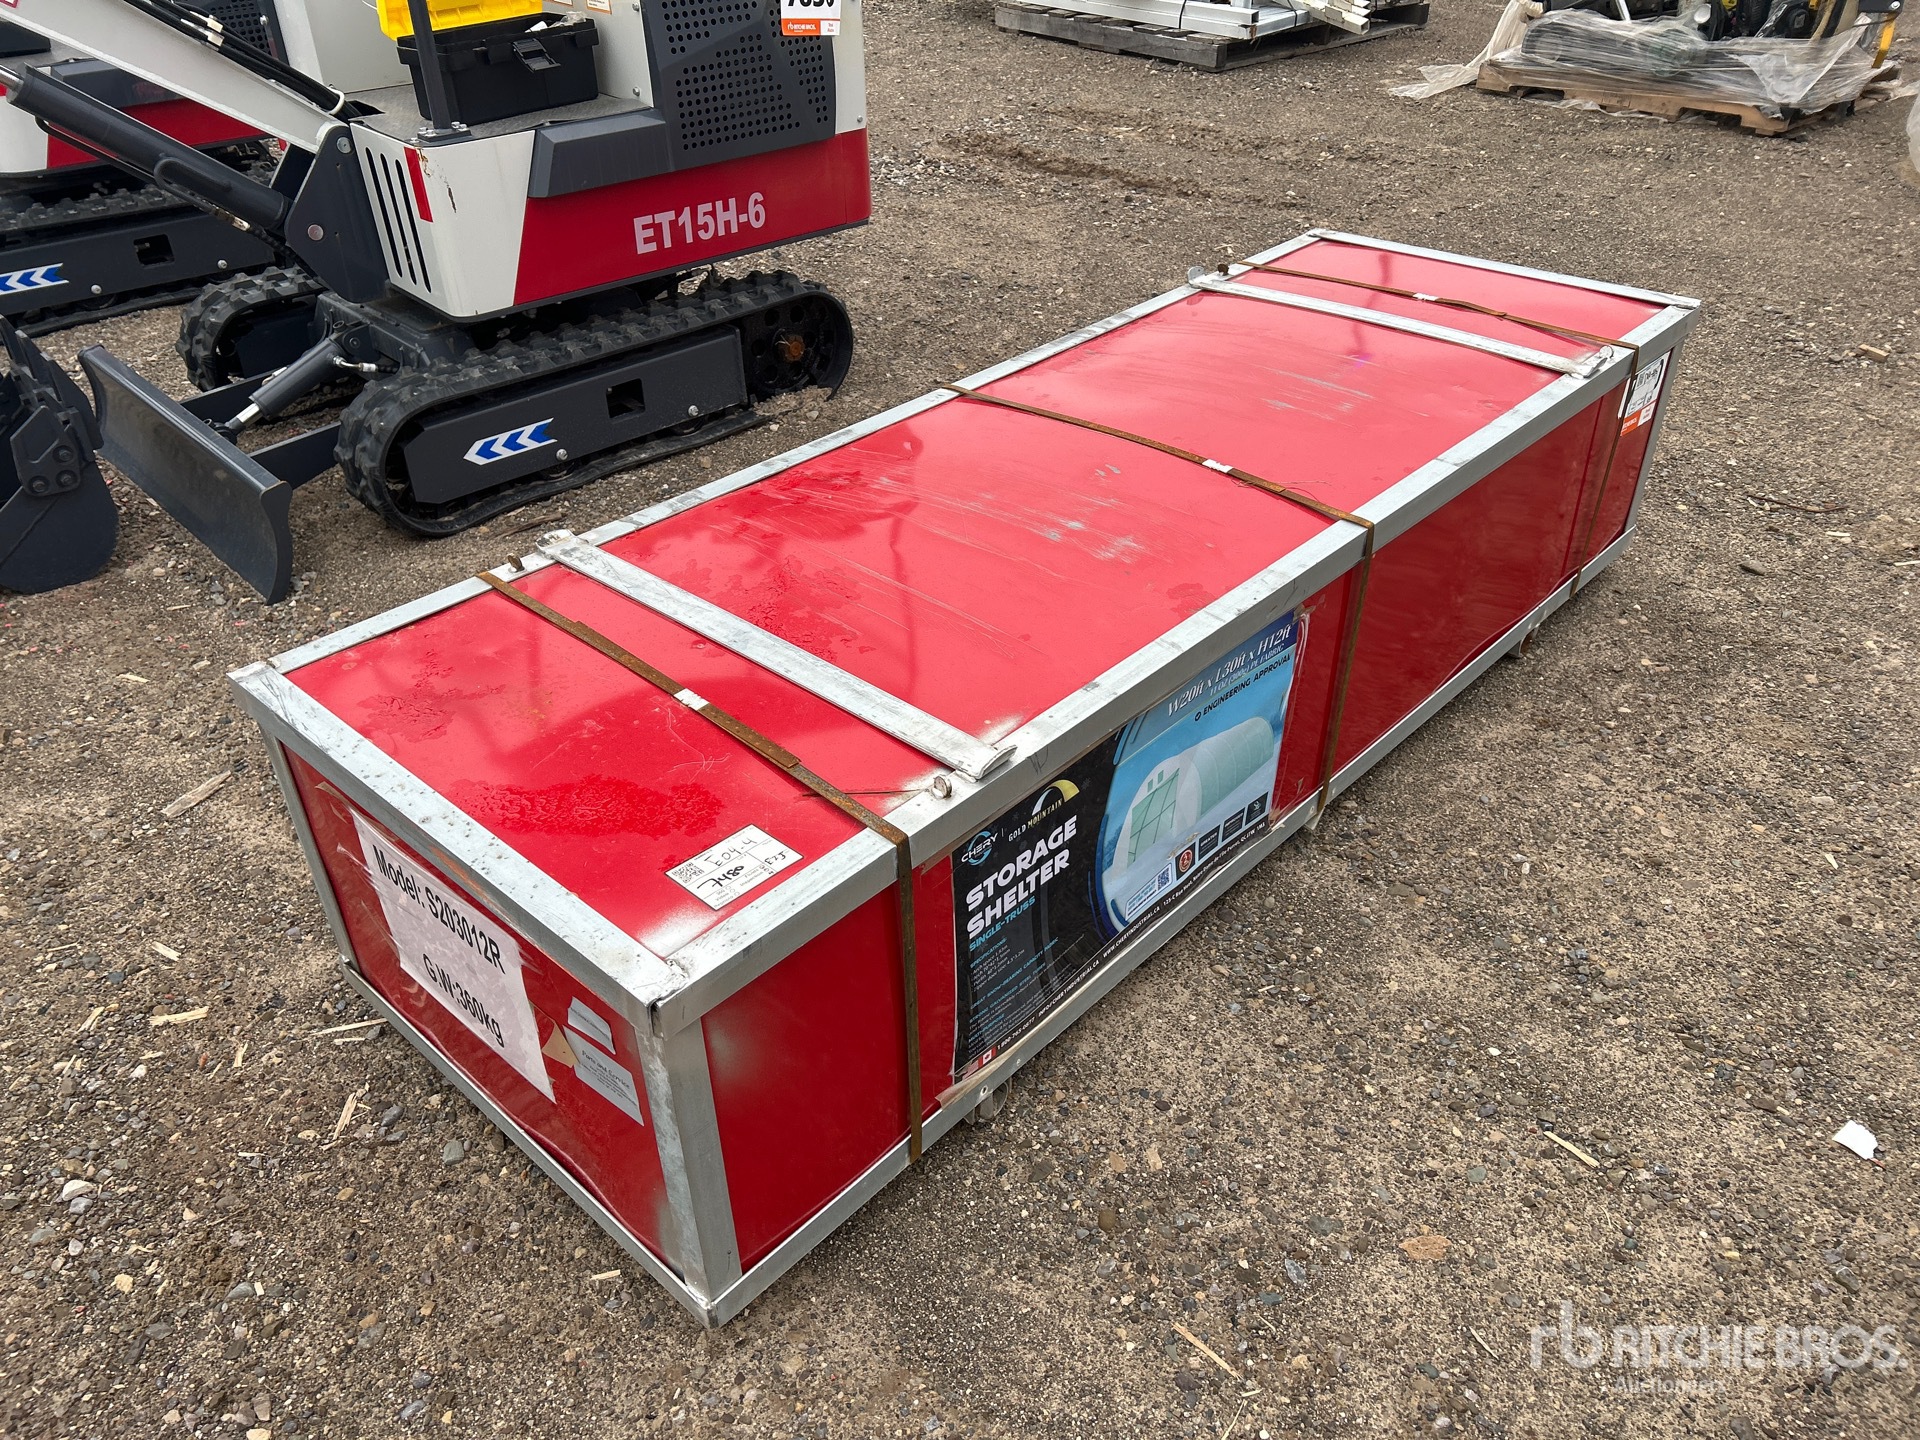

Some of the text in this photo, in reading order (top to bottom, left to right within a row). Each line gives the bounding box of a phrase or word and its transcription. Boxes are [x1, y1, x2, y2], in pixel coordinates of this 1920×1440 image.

[633, 192, 766, 254] ET15H-6
[1168, 680, 1204, 717] W20ft
[1215, 651, 1246, 683] L30ft
[1257, 623, 1291, 656] H12ft
[1203, 653, 1291, 716] ENGINEERING APPROVAL
[961, 832, 998, 862] CHERY
[1008, 798, 1063, 842] GOLD MOUNTAIN
[965, 815, 1077, 913] STORAGE
[966, 849, 1070, 941] SHELTER
[372, 845, 506, 975] Model: S203012R
[969, 895, 1036, 952] SINGLE-TRUSS
[422, 953, 505, 1048] G.W:360kg
